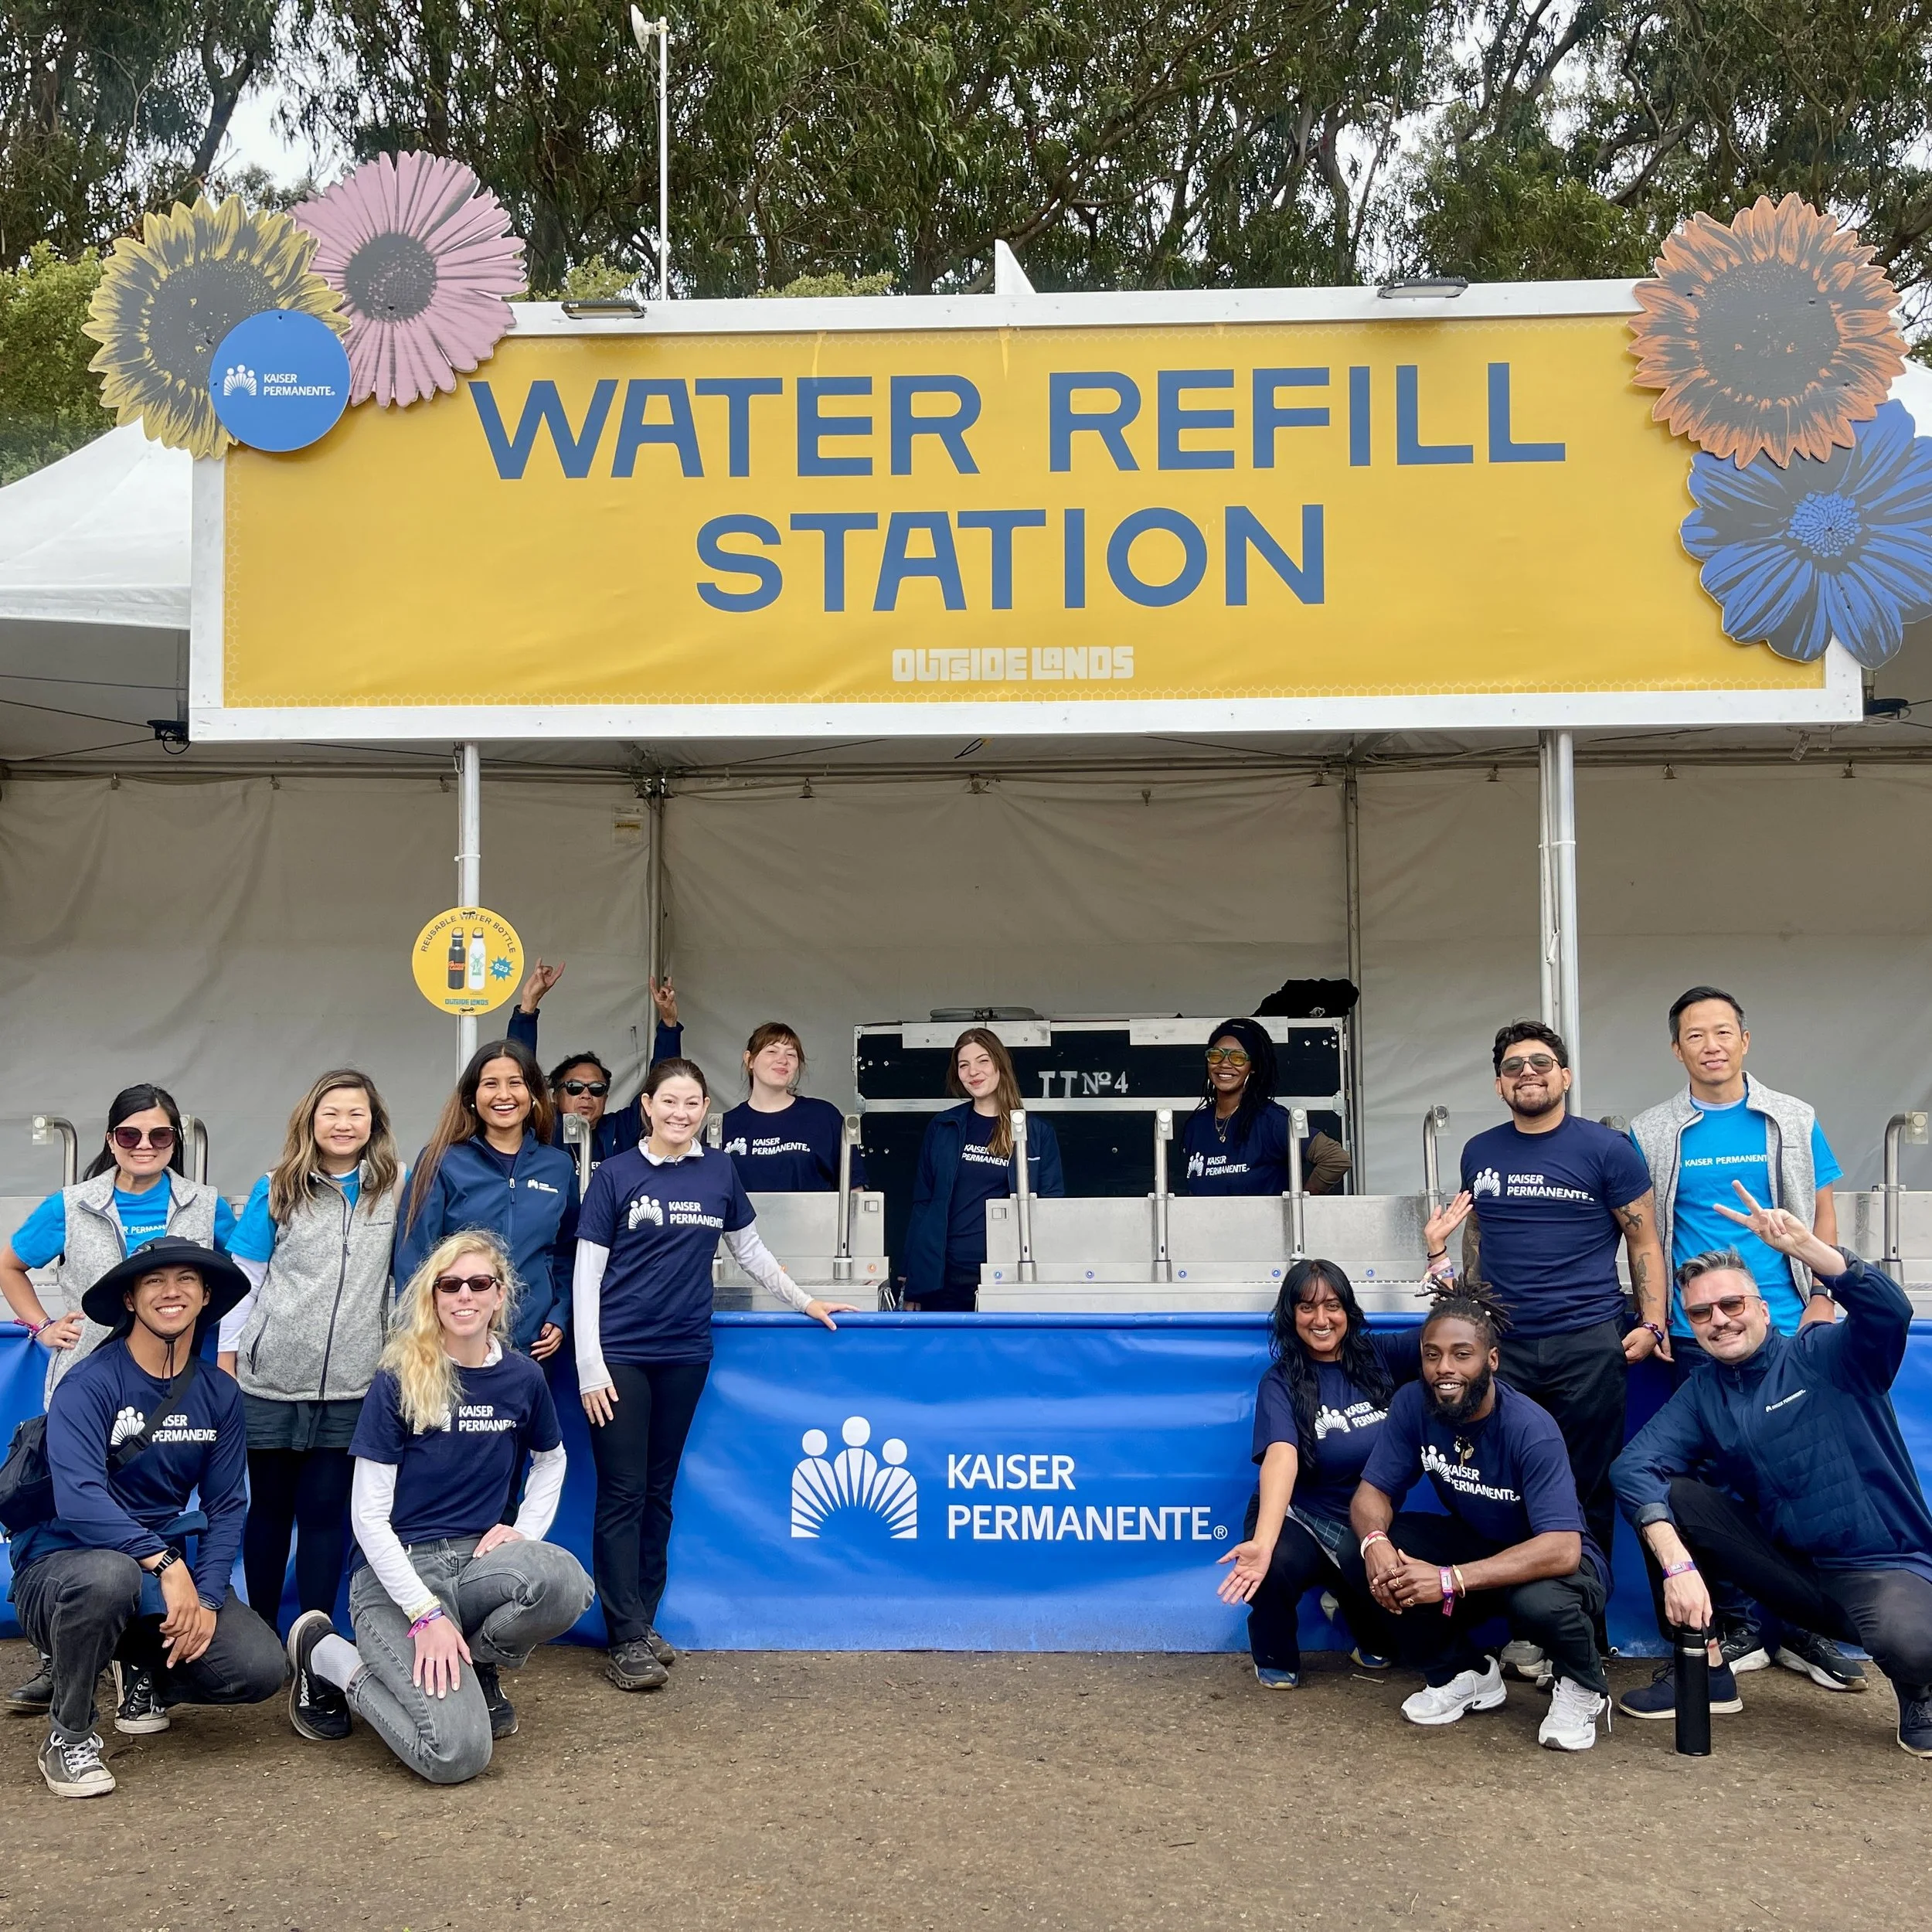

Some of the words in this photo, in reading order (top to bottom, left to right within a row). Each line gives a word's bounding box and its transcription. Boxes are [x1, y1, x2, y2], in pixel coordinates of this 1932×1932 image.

[264, 373, 298, 383] KAISER
[468, 374, 982, 480] WATER
[1049, 362, 1566, 473] REFILL
[696, 504, 1325, 613] STATION
[892, 647, 1027, 682] OUTSIDE
[1032, 646, 1134, 680] LANDS
[420, 915, 457, 952] REUSABLE
[492, 922, 516, 954] BOTTLE
[494, 963, 509, 973] $23
[1114, 1071, 1128, 1094] 4
[753, 1137, 781, 1146] KAISER
[961, 1152, 1009, 1167] PERMANENT
[1685, 1158, 1713, 1167] KAISER
[1716, 1155, 1767, 1165] PERMANENT
[1507, 1174, 1544, 1184] KAISER
[668, 1201, 702, 1212] KAISER
[131, 1224, 167, 1234] PERMAN
[458, 1405, 494, 1417] KAISER
[947, 1454, 1077, 1491] KAISER
